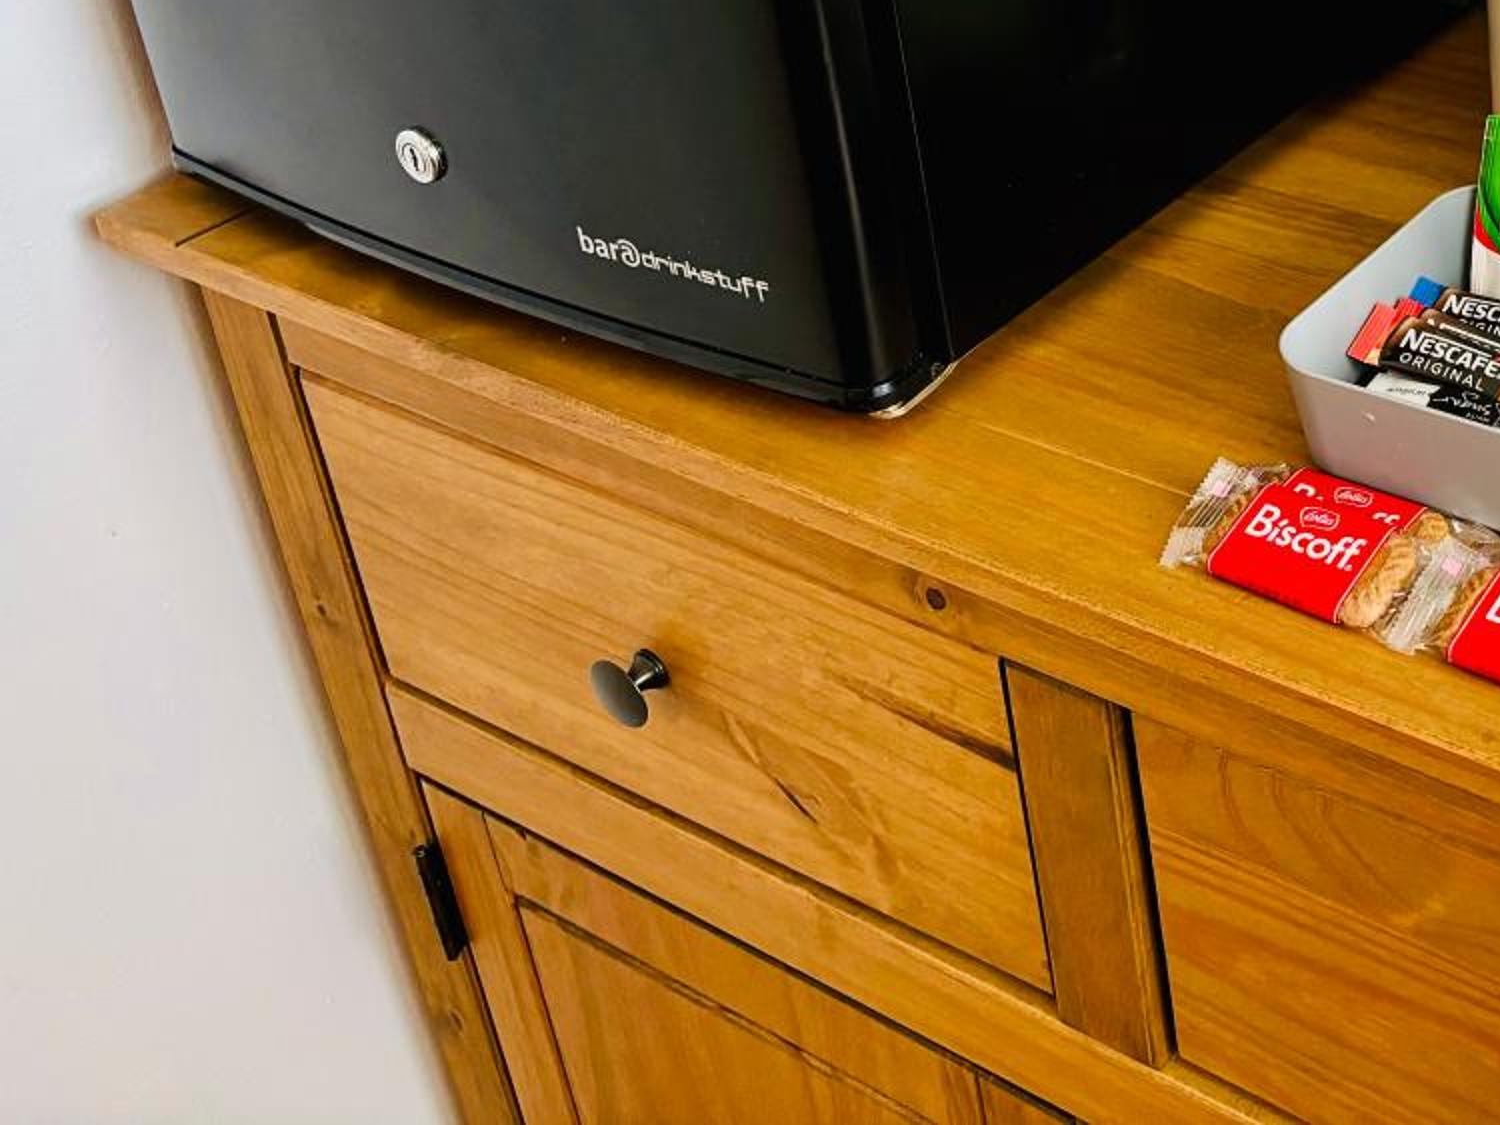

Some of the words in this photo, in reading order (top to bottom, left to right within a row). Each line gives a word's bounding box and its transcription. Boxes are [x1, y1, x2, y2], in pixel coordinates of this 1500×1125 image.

[575, 225, 770, 303] bar@drinkstuff
[1399, 351, 1485, 393] ORIGINAL
[1244, 503, 1368, 572] Biscoff
